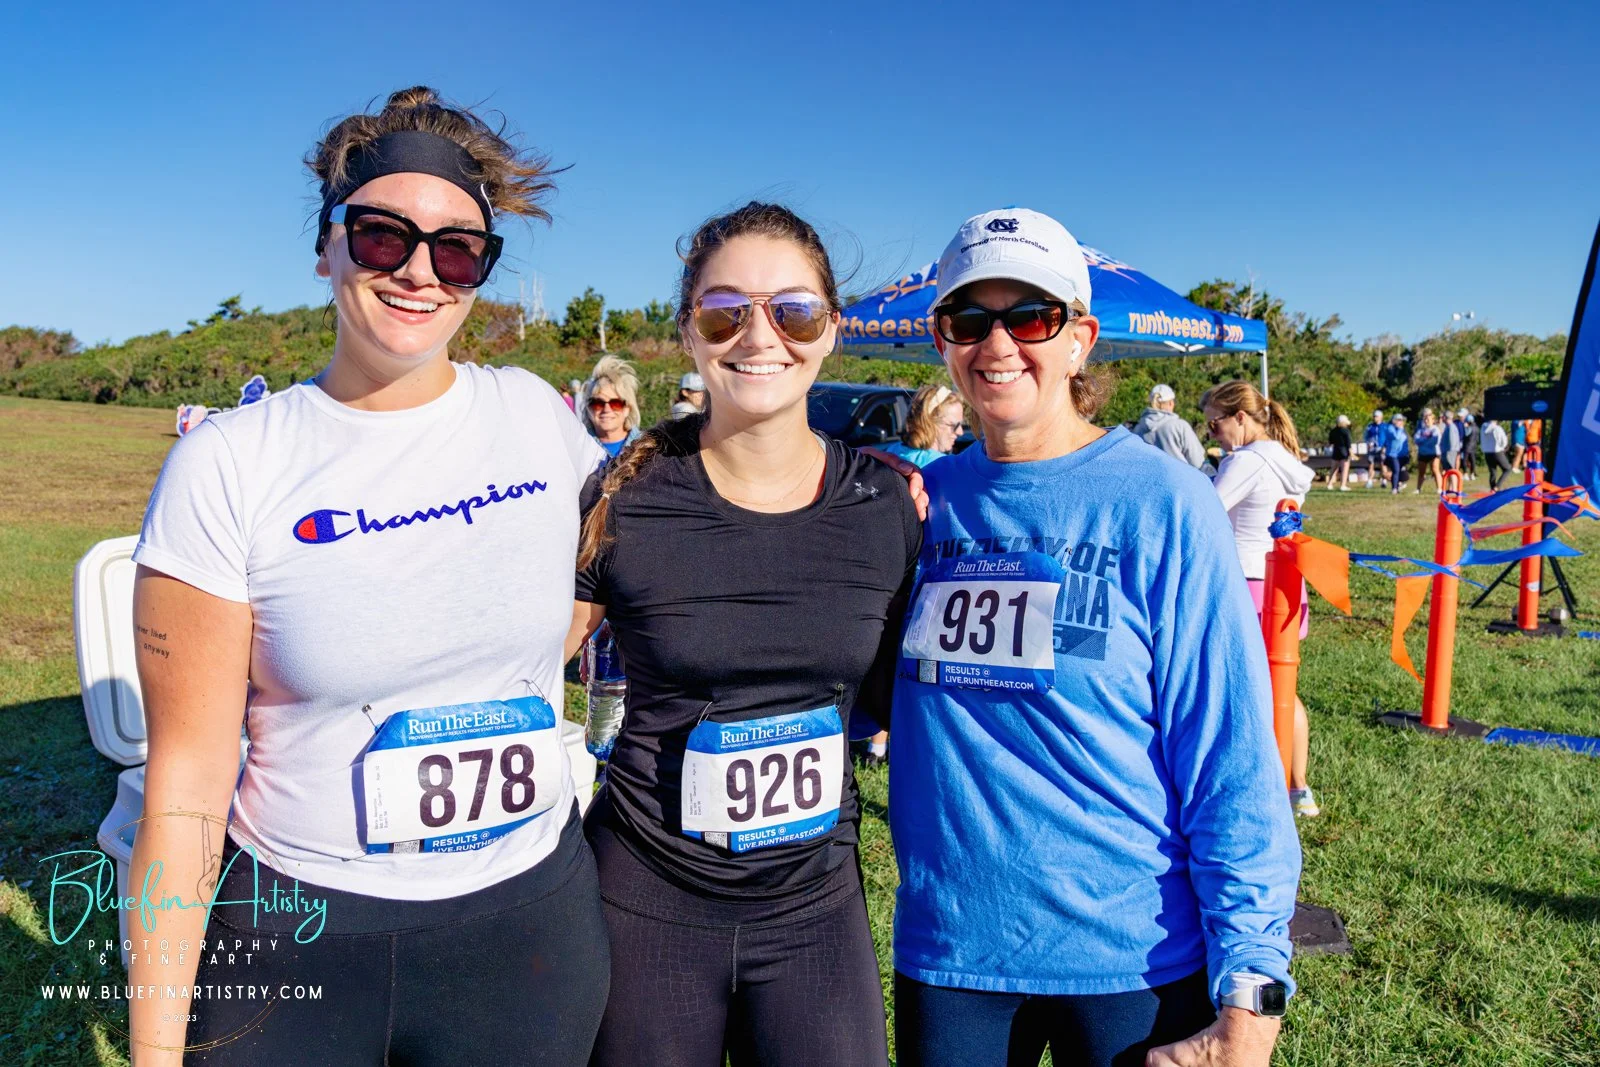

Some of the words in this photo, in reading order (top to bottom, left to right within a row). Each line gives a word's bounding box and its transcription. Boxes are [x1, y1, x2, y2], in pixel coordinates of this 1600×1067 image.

[1019, 237, 1049, 253] Carolina
[841, 315, 935, 338] theeast
[293, 478, 547, 544] Champion
[1069, 541, 1120, 577] OF
[939, 589, 1029, 657] 931
[151, 628, 167, 640] liked
[144, 643, 169, 659] anyway
[945, 665, 980, 676] RESULTS
[982, 668, 990, 677] @
[945, 676, 1034, 690] LIVE.RUNTHEEAST.COM
[418, 743, 536, 828] 878
[726, 747, 822, 822] 926
[432, 834, 478, 847] RESULTS
[480, 831, 490, 840] @
[738, 829, 776, 842] RESULTS
[778, 826, 786, 836] @
[738, 825, 824, 851] LIVE.RUNTHEEAST.COM
